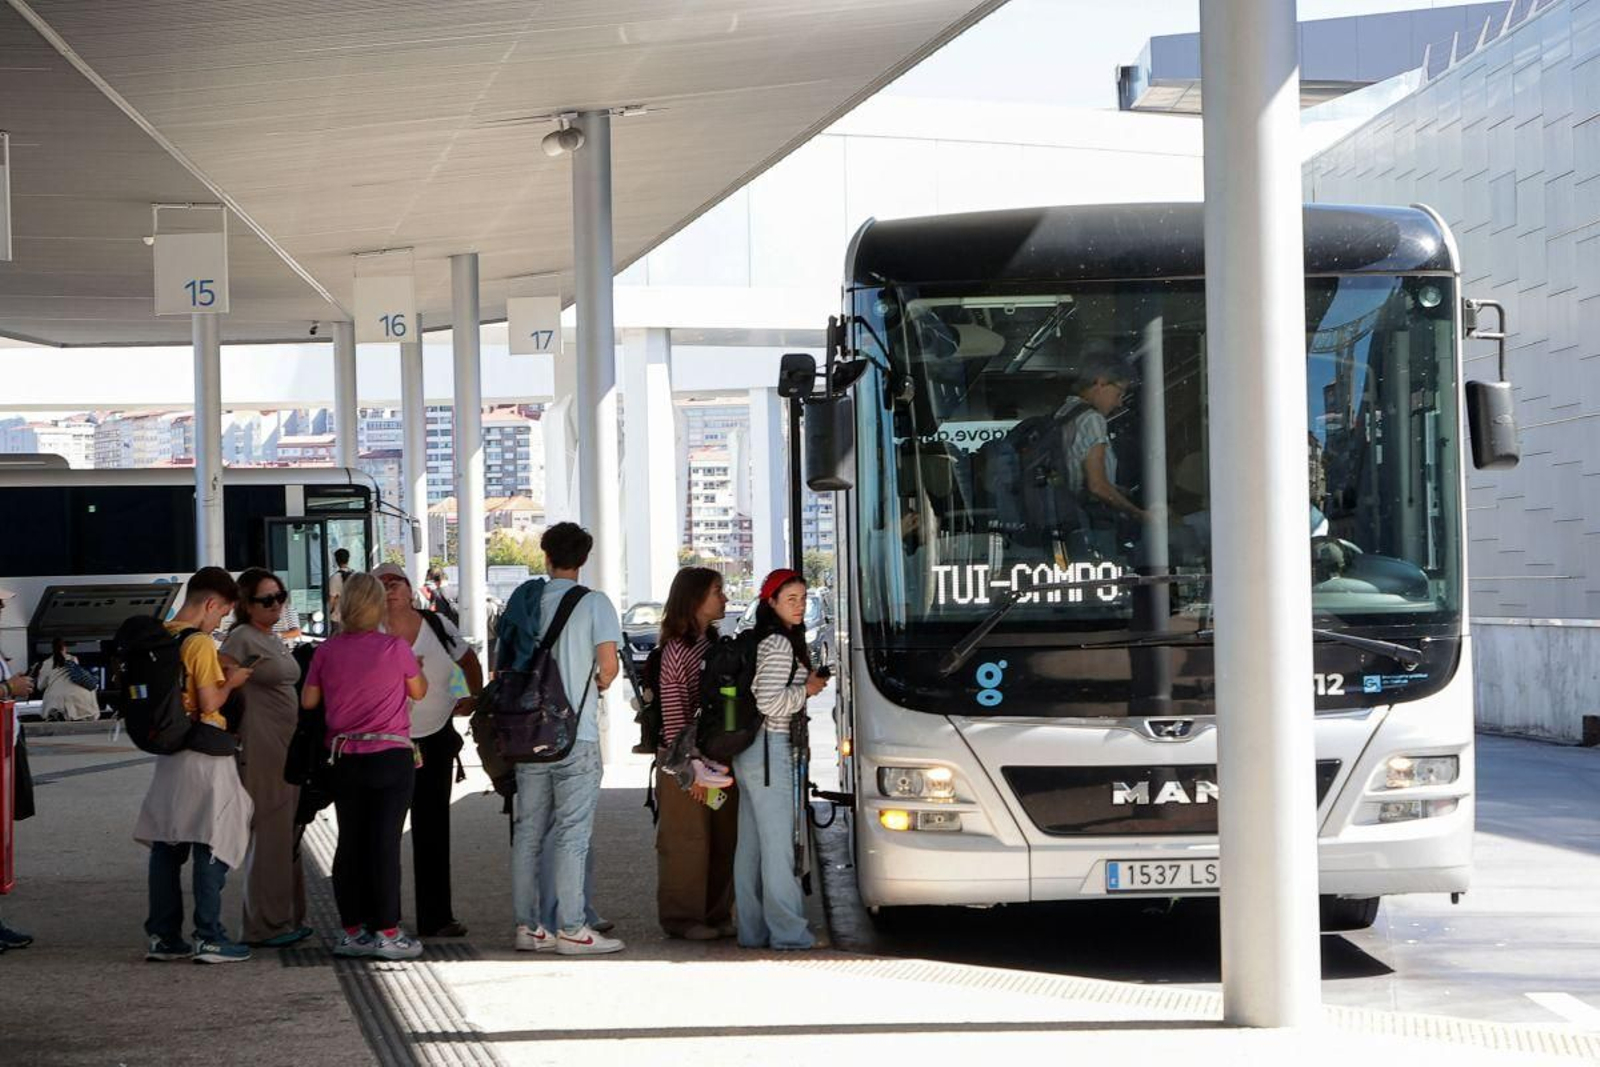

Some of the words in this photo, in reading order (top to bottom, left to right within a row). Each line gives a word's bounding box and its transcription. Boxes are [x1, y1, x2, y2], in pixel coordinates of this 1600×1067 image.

[184, 279, 215, 306] 15
[379, 314, 406, 337] 16
[531, 330, 553, 350] 17
[931, 562, 1125, 605] TUI-CAMPO
[1313, 673, 1345, 695] 12
[1112, 780, 1219, 805] MAN
[1128, 864, 1181, 885] 1537
[1190, 863, 1218, 885] LS
